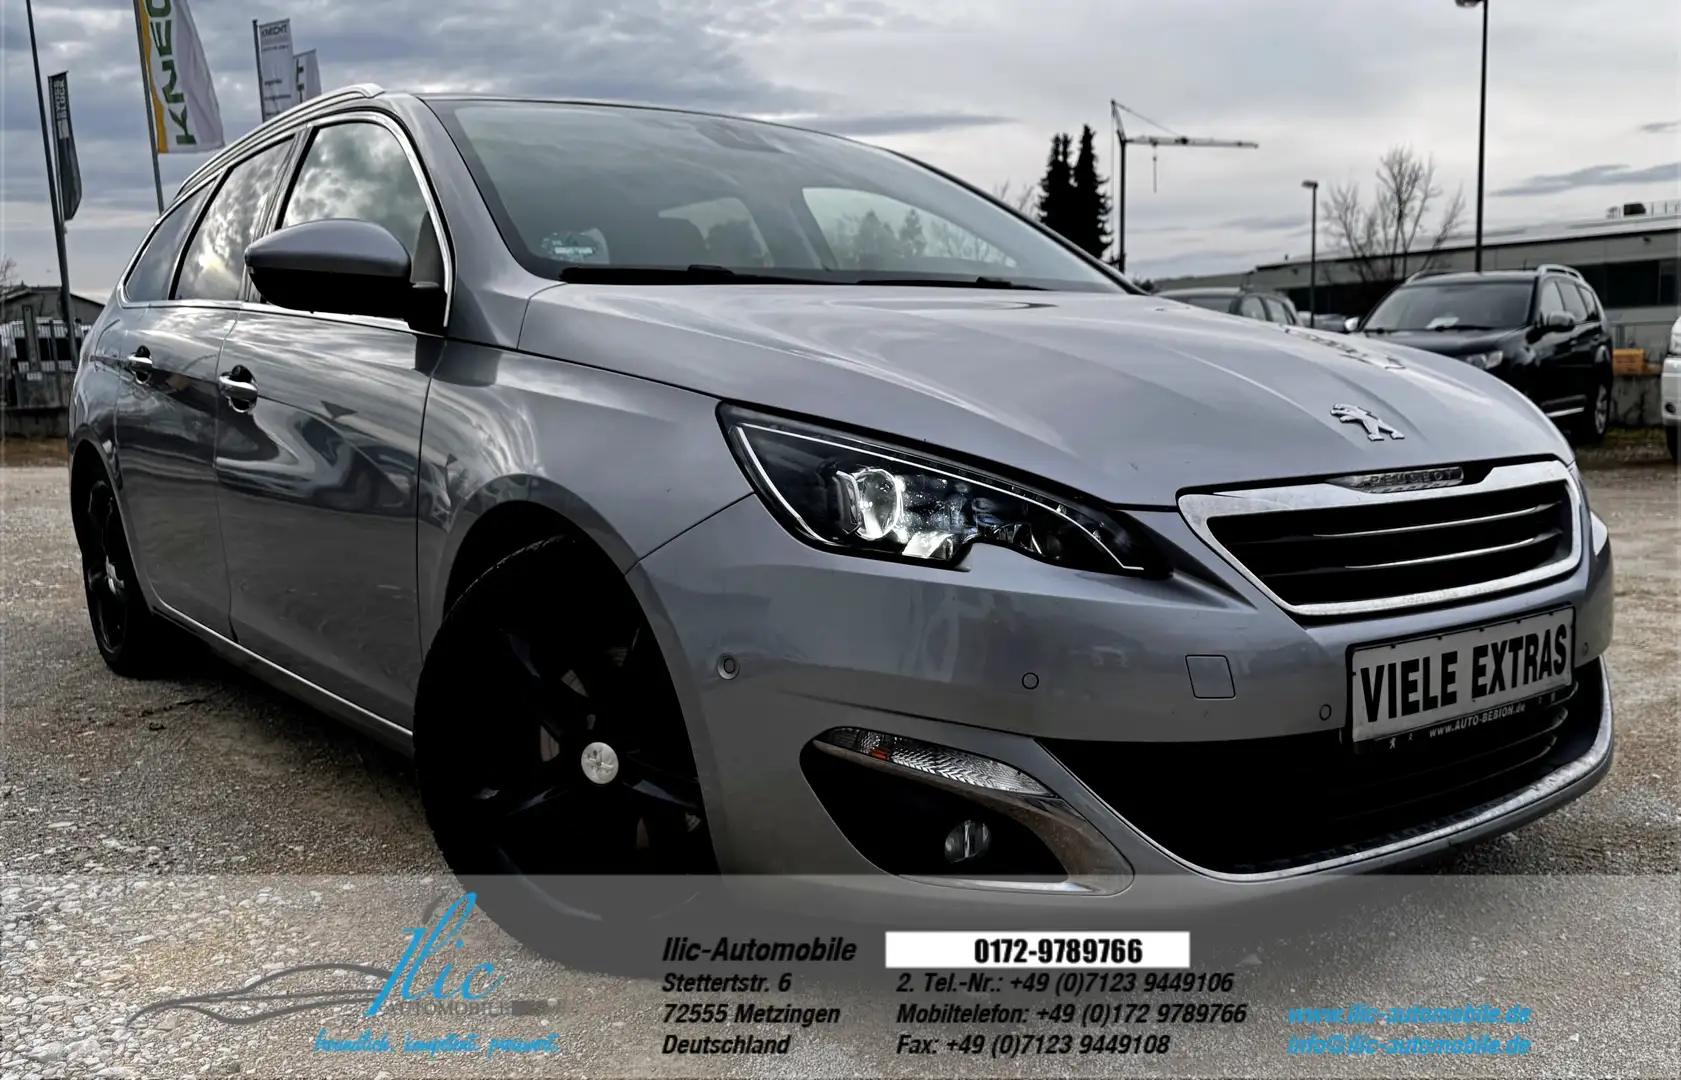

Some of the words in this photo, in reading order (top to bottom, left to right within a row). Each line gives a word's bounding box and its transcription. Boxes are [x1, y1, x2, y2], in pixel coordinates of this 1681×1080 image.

[1360, 651, 1458, 723] VIELE
[1471, 624, 1567, 699] EXTRAS
[1429, 703, 1527, 738] www.AUTO-BEBION.de
